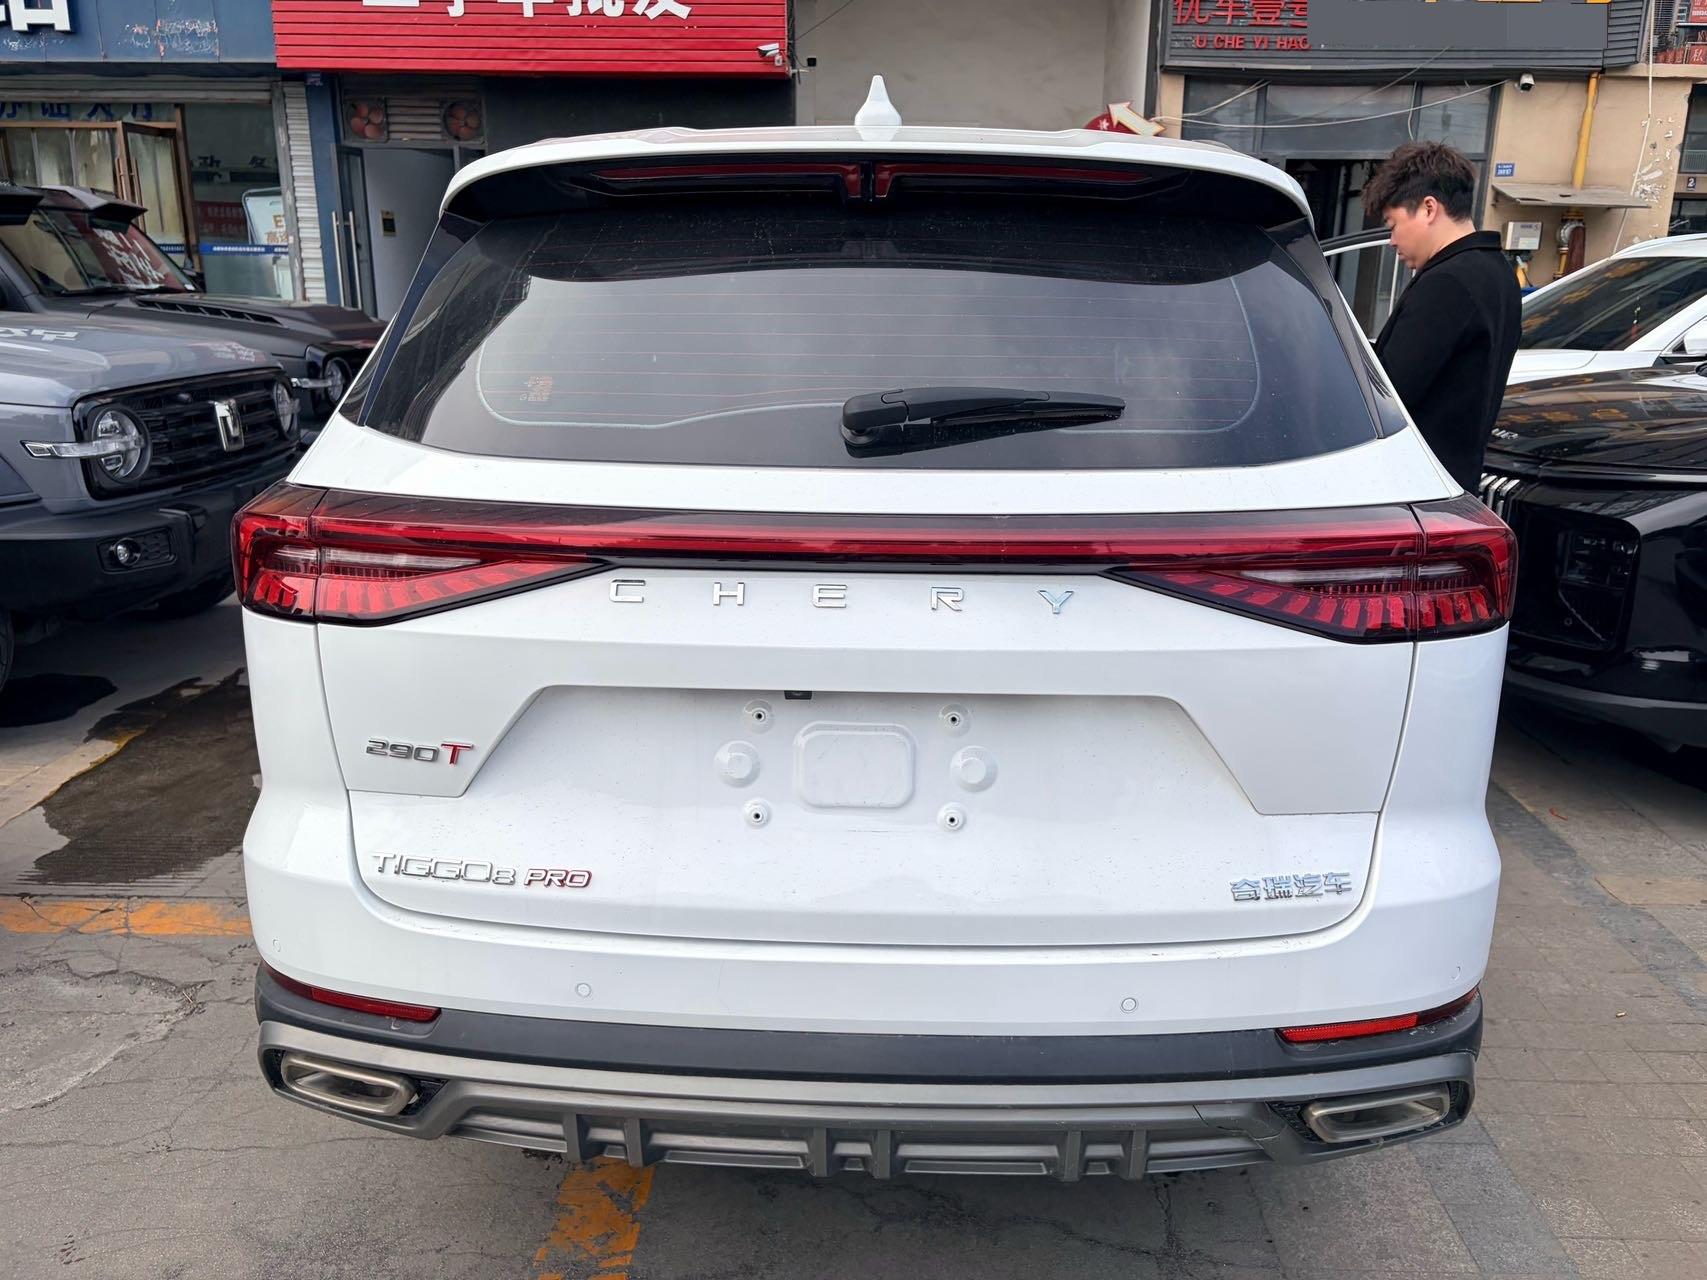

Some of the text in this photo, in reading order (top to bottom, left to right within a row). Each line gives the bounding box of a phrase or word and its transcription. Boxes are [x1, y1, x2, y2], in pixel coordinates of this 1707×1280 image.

[1213, 35, 1245, 49] CHE
[1687, 178, 1695, 187] 2
[609, 579, 1074, 615] CHERY
[366, 738, 475, 767] 290T
[524, 868, 593, 888] PRO
[1230, 871, 1352, 902] 奇瑞汽车
